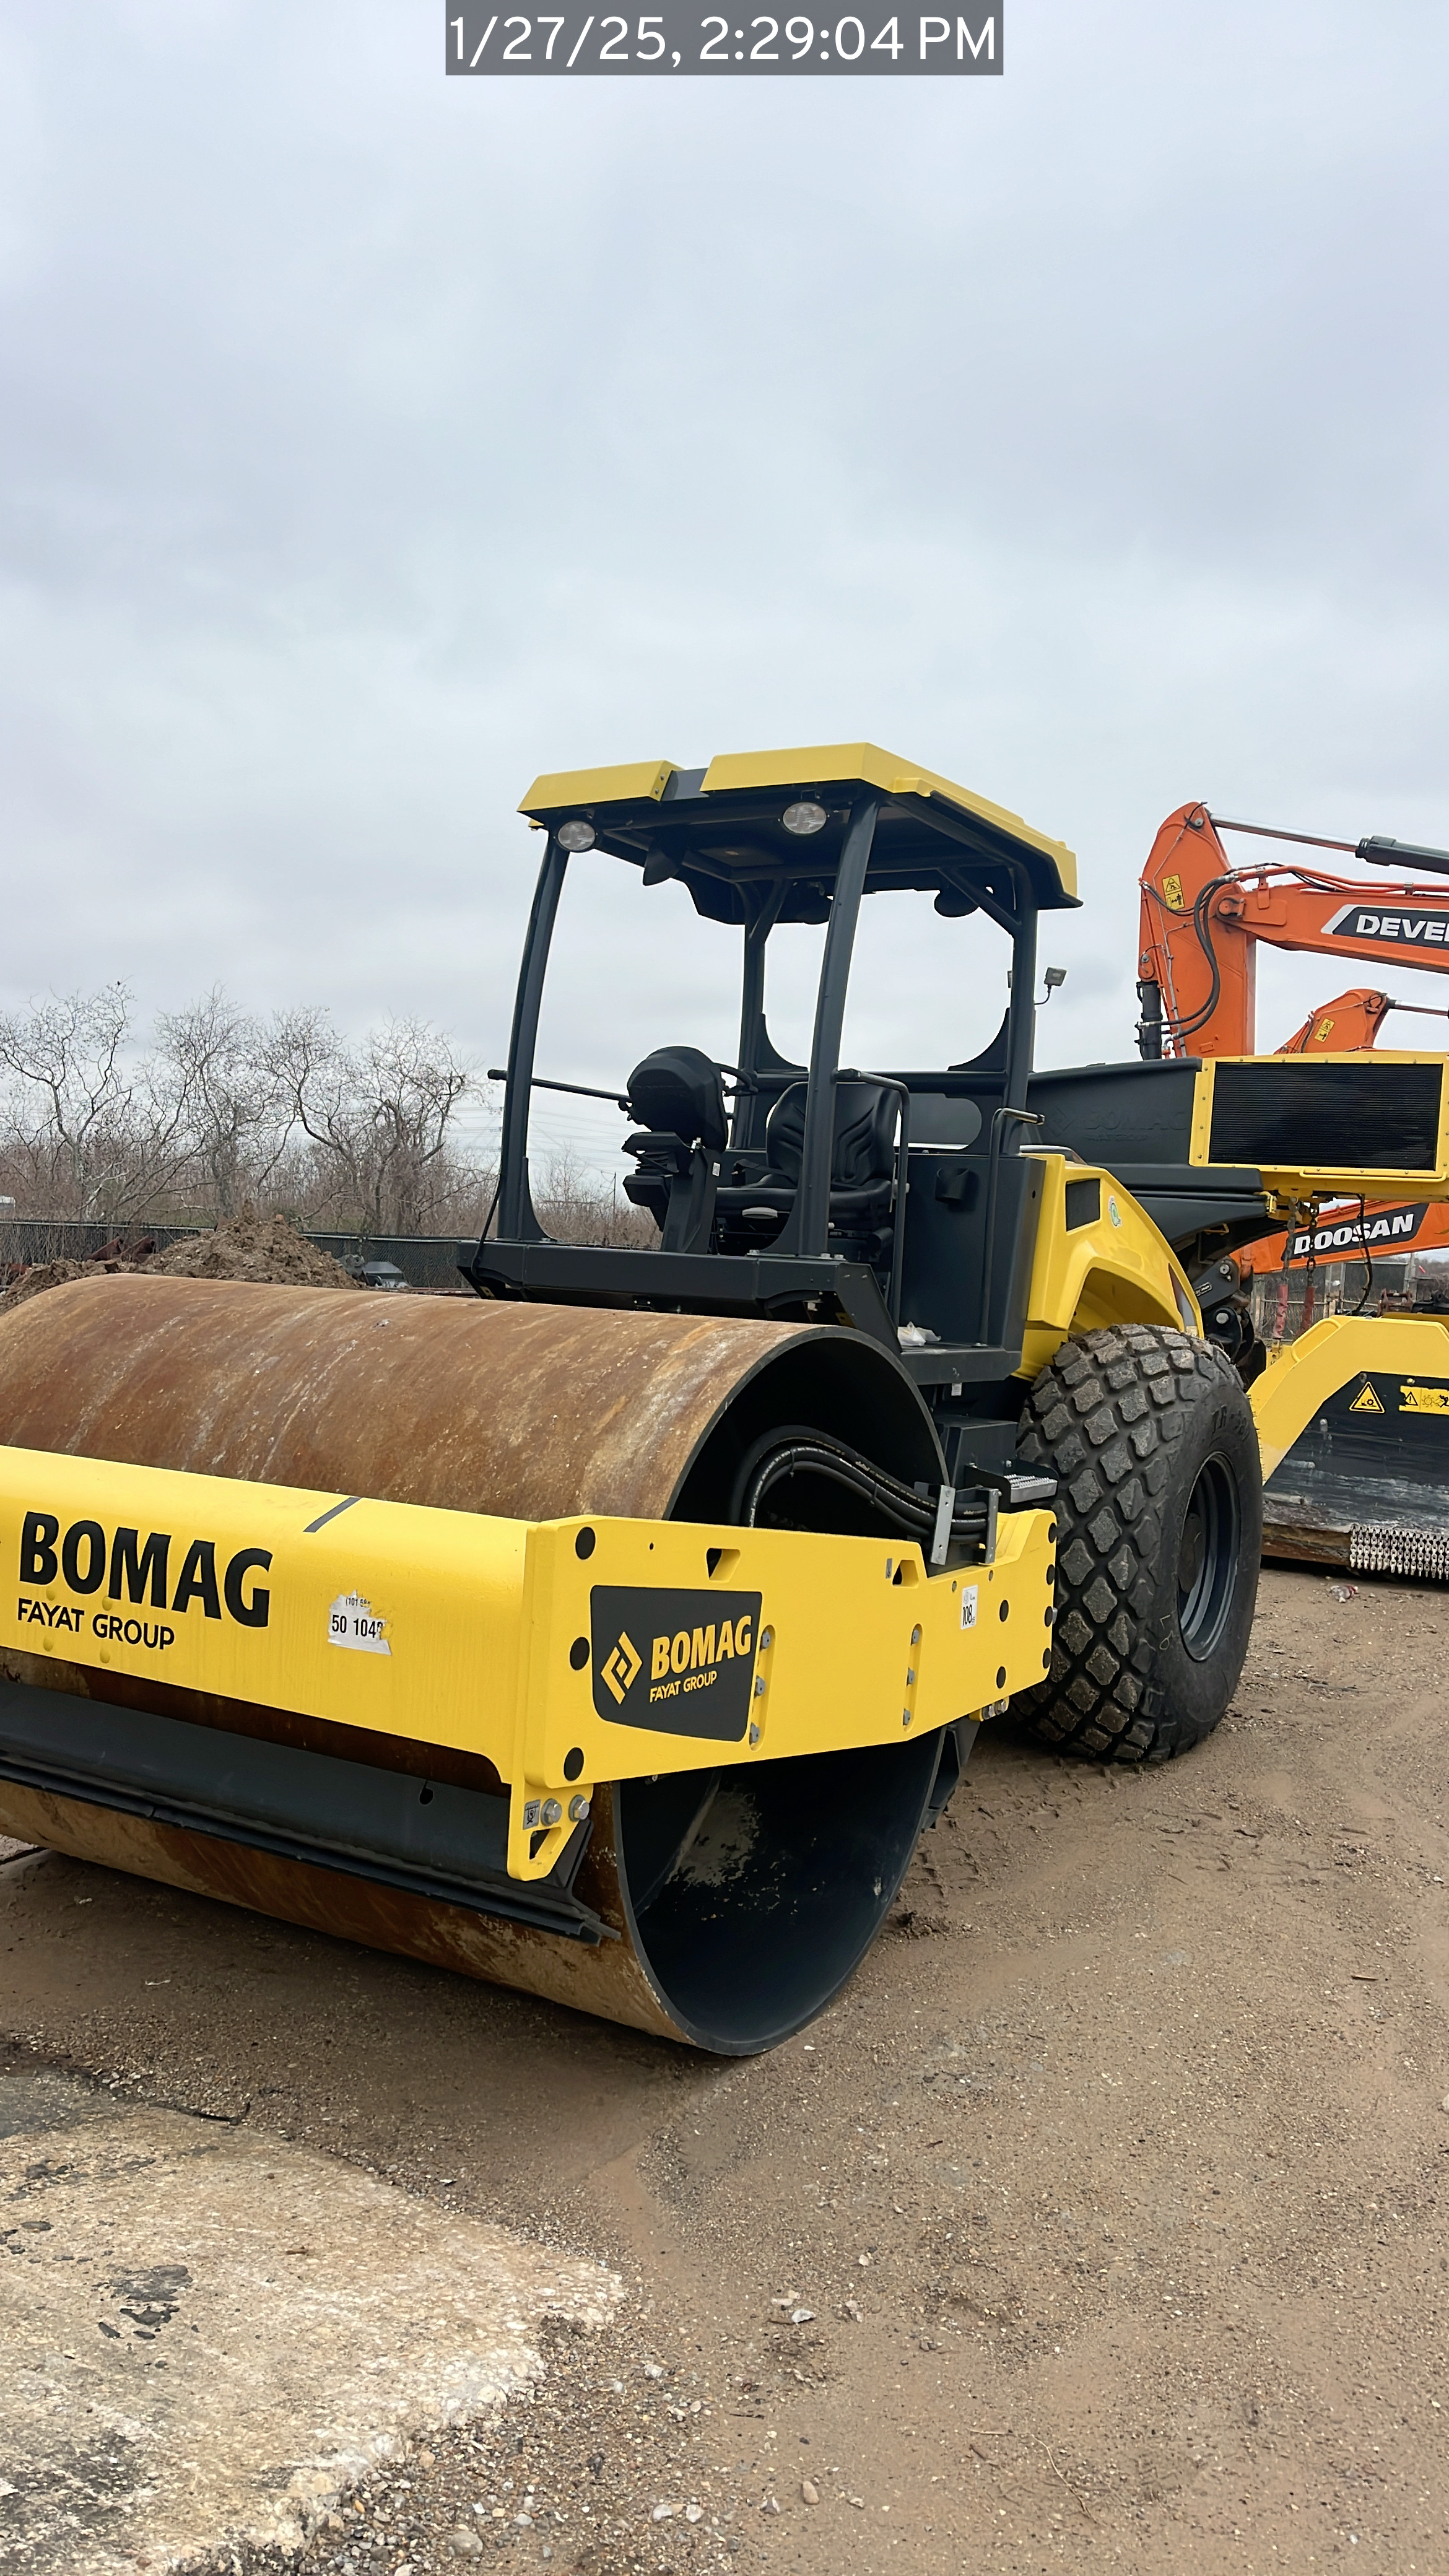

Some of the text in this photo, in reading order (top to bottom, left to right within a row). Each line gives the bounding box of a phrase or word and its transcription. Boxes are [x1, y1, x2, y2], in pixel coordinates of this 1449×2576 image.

[1356, 915, 1449, 942] DEVE
[1294, 1213, 1414, 1255] DOOSAN
[19, 1511, 273, 1628] BOMAG
[17, 1598, 175, 1650] FAYAT GROUP
[332, 1614, 347, 1634] 50
[962, 1604, 973, 1626] 108
[651, 1615, 752, 1681] BOMAG
[650, 1670, 717, 1703] FAYAT GROUP
